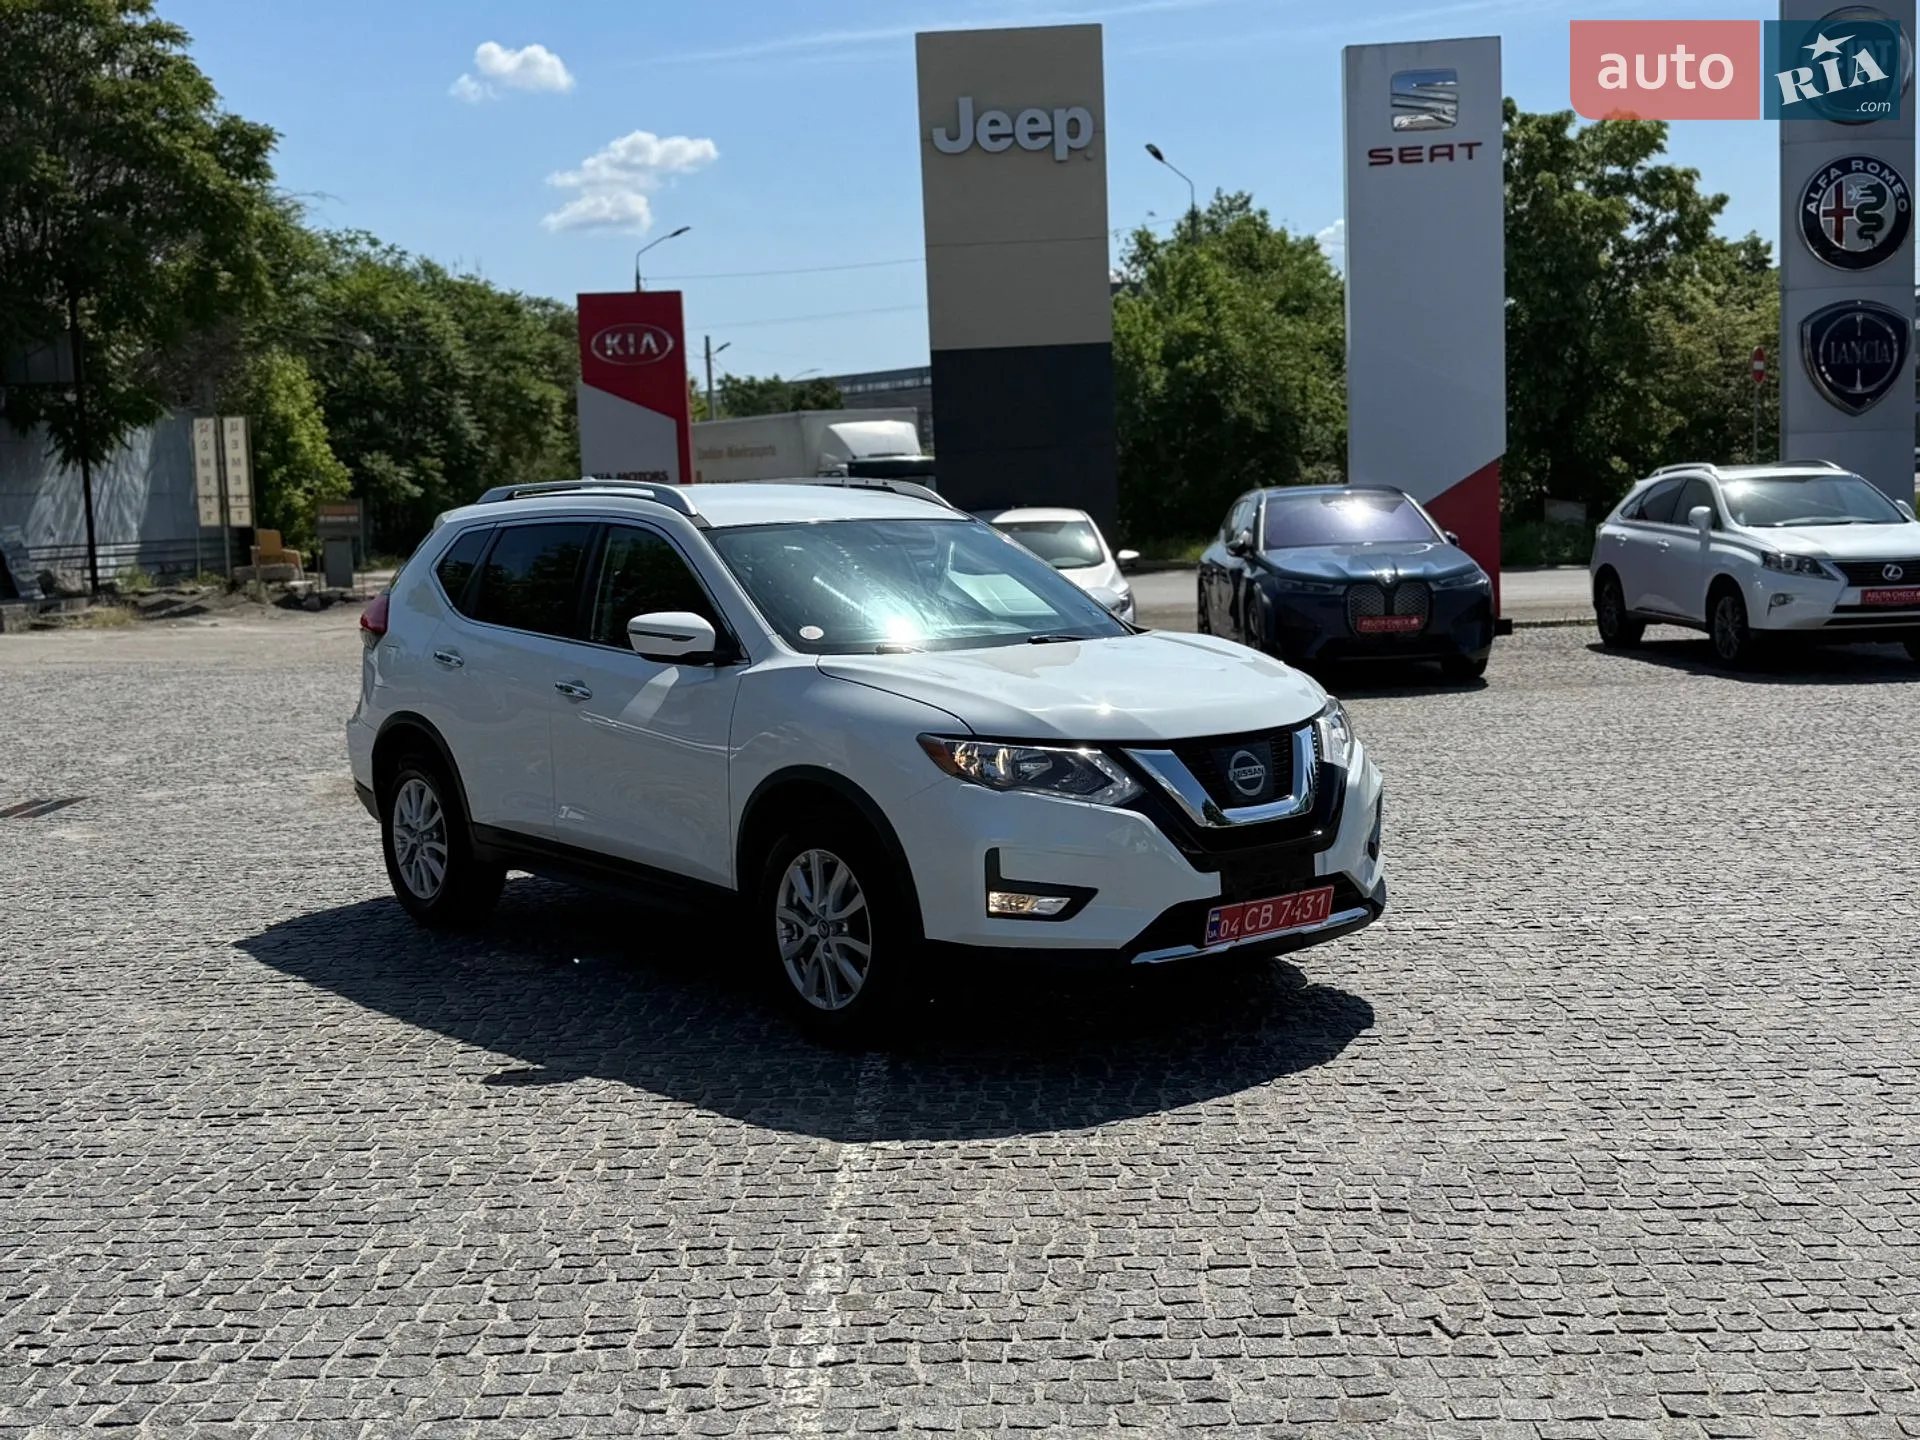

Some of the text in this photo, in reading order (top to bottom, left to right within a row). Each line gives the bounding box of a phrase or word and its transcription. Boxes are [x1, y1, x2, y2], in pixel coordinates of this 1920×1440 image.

[932, 96, 1094, 161] Jeep
[1368, 142, 1483, 166] SEAT
[1806, 160, 1908, 215] ALFA ROMEO
[605, 332, 659, 356] KIA
[1830, 340, 1891, 364] LANCIA
[616, 470, 669, 481] MOTORS
[1233, 766, 1264, 777] NISSAN
[1220, 917, 1240, 937] 04
[1244, 904, 1273, 931] CB
[1279, 893, 1326, 924] 7431
